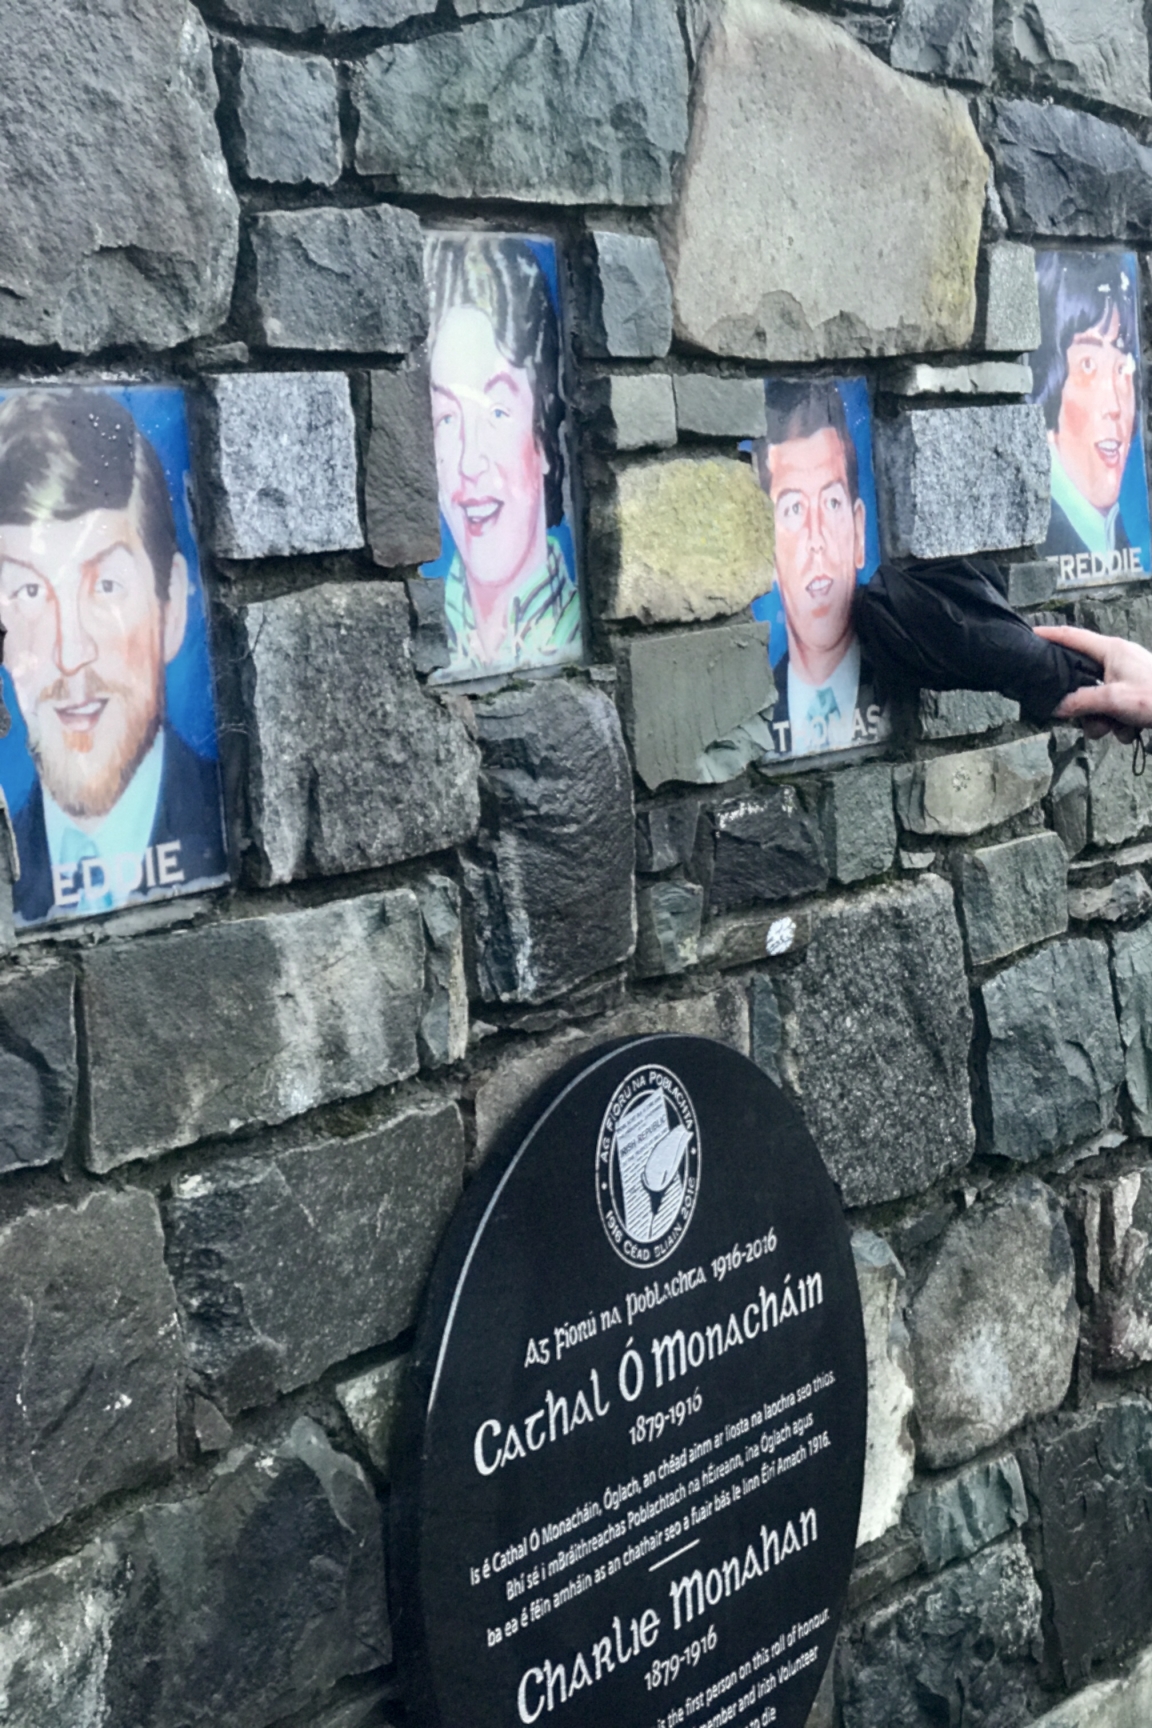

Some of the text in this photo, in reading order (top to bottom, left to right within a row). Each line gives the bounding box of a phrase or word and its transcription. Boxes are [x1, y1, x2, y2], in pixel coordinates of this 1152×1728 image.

[773, 704, 880, 753] TOAS
[52, 840, 185, 906] EDDIE
[600, 1307, 622, 1331] na
[711, 1227, 777, 1281] 1916-2016
[474, 1368, 610, 1476] Cathal
[618, 1336, 645, 1402] Ó
[629, 1386, 703, 1445] 1879-1916
[470, 1567, 481, 1586] Is
[482, 1558, 490, 1579] é
[492, 1536, 528, 1573] Cathal
[529, 1528, 540, 1552] Ó
[541, 1501, 602, 1545] Monacháin,
[603, 1476, 642, 1511] Óglach,
[643, 1470, 656, 1488] an
[657, 1447, 687, 1480] chéad
[688, 1438, 712, 1463] ainm
[713, 1432, 723, 1449] ar
[725, 1417, 751, 1442] liosta
[751, 1411, 763, 1427] na
[764, 1393, 796, 1420] laochra
[796, 1383, 812, 1402] seo
[505, 1412, 814, 1601] Bhí sé i mBráithreachas Poblachtach na hÉireann, ina Óglach agus
[486, 1627, 503, 1648] ba
[504, 1618, 518, 1637] ea
[520, 1607, 529, 1628] é
[530, 1597, 551, 1623] féin
[553, 1573, 592, 1609] amháin
[593, 1566, 606, 1584] as
[607, 1557, 621, 1576] an
[623, 1530, 664, 1567] chathair
[664, 1521, 682, 1543] seo
[683, 1515, 690, 1531] a
[691, 1500, 713, 1526] fuair
[714, 1489, 732, 1512] bás
[731, 1484, 741, 1502] le
[742, 1474, 760, 1496] linn
[777, 1444, 807, 1475] Amach
[807, 1431, 831, 1456] 1916.
[517, 1507, 818, 1724] Charlie Monahan
[644, 1624, 718, 1690] 1879-1916
[667, 1707, 684, 1728] the
[684, 1691, 705, 1716] first
[706, 1671, 737, 1707] person
[738, 1661, 752, 1680] on
[752, 1647, 770, 1671] this
[770, 1634, 786, 1658] roll
[786, 1625, 796, 1647] of
[797, 1608, 830, 1640] honour.
[738, 1685, 756, 1712] and
[757, 1673, 777, 1699] Irish
[777, 1646, 818, 1684] Volunteer
[761, 1706, 776, 1727] die
